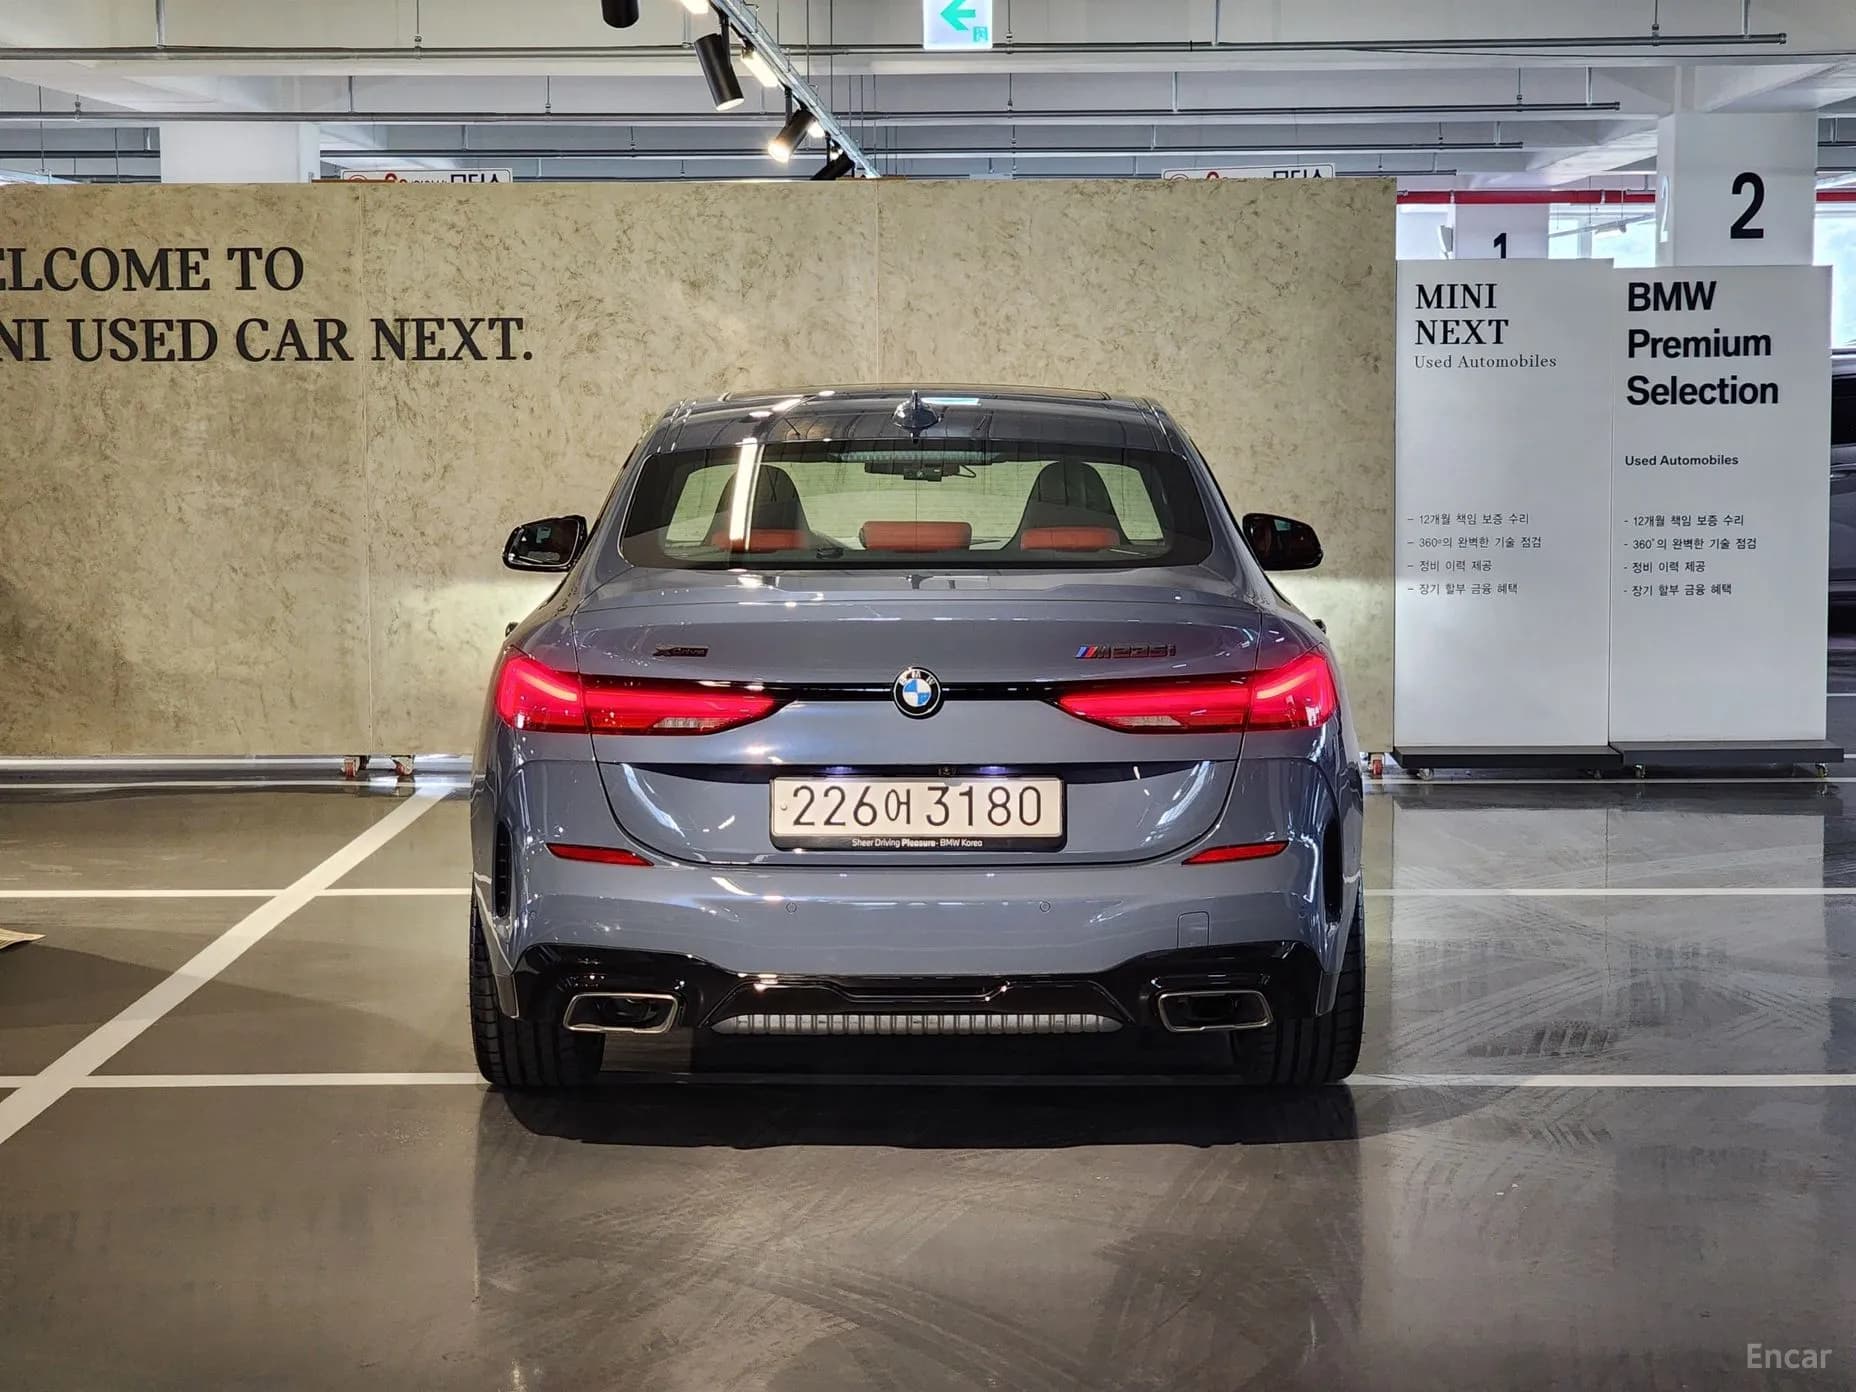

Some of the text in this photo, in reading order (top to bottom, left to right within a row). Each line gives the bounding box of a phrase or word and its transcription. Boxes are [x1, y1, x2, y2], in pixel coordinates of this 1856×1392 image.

[1730, 172, 1765, 239] 2
[0, 246, 304, 292] LCOME TO
[1415, 283, 1497, 310] MINI
[1628, 280, 1717, 312] BMW
[1415, 319, 1509, 345] NEXT
[66, 317, 218, 362] USED
[235, 317, 354, 362] CAR
[370, 317, 533, 361] NEXT.
[1628, 328, 1772, 359] Premium
[1415, 354, 1557, 368] Used Automobiles
[1626, 375, 1779, 406] Selection
[1625, 455, 1739, 466] Used Automobiles
[1419, 514, 1451, 525] 12개월
[1456, 513, 1477, 525] 책임
[1482, 514, 1503, 525] 보증
[1509, 513, 1530, 524] 수리
[1633, 515, 1665, 527] 12개월
[1671, 515, 1692, 527] 책임
[1697, 516, 1718, 526] 보증
[1723, 515, 1745, 526] 수리
[1458, 537, 1489, 548] 완벽한
[1495, 537, 1516, 548] 기술
[1521, 537, 1542, 548] 점검
[1672, 538, 1705, 550] 완벽한
[1710, 538, 1731, 549] 기술
[1736, 537, 1757, 549] 점검
[1419, 560, 1440, 571] 정비
[1446, 560, 1466, 571] 이력
[1472, 560, 1492, 571] 제공
[1632, 562, 1653, 573] 정비
[1658, 561, 1680, 573] 이력
[1685, 561, 1706, 573] 제공
[1419, 583, 1440, 595] 장기
[1446, 583, 1466, 595] 할부
[1471, 583, 1492, 595] 금융
[1497, 583, 1518, 594] 혜택
[1632, 585, 1653, 597] 장기
[1659, 585, 1680, 597] 할부
[1684, 584, 1706, 596] 금융
[1711, 584, 1732, 595] 혜택
[852, 839, 874, 847] Sheer
[874, 839, 900, 848] Driving
[961, 839, 983, 847] Korea
